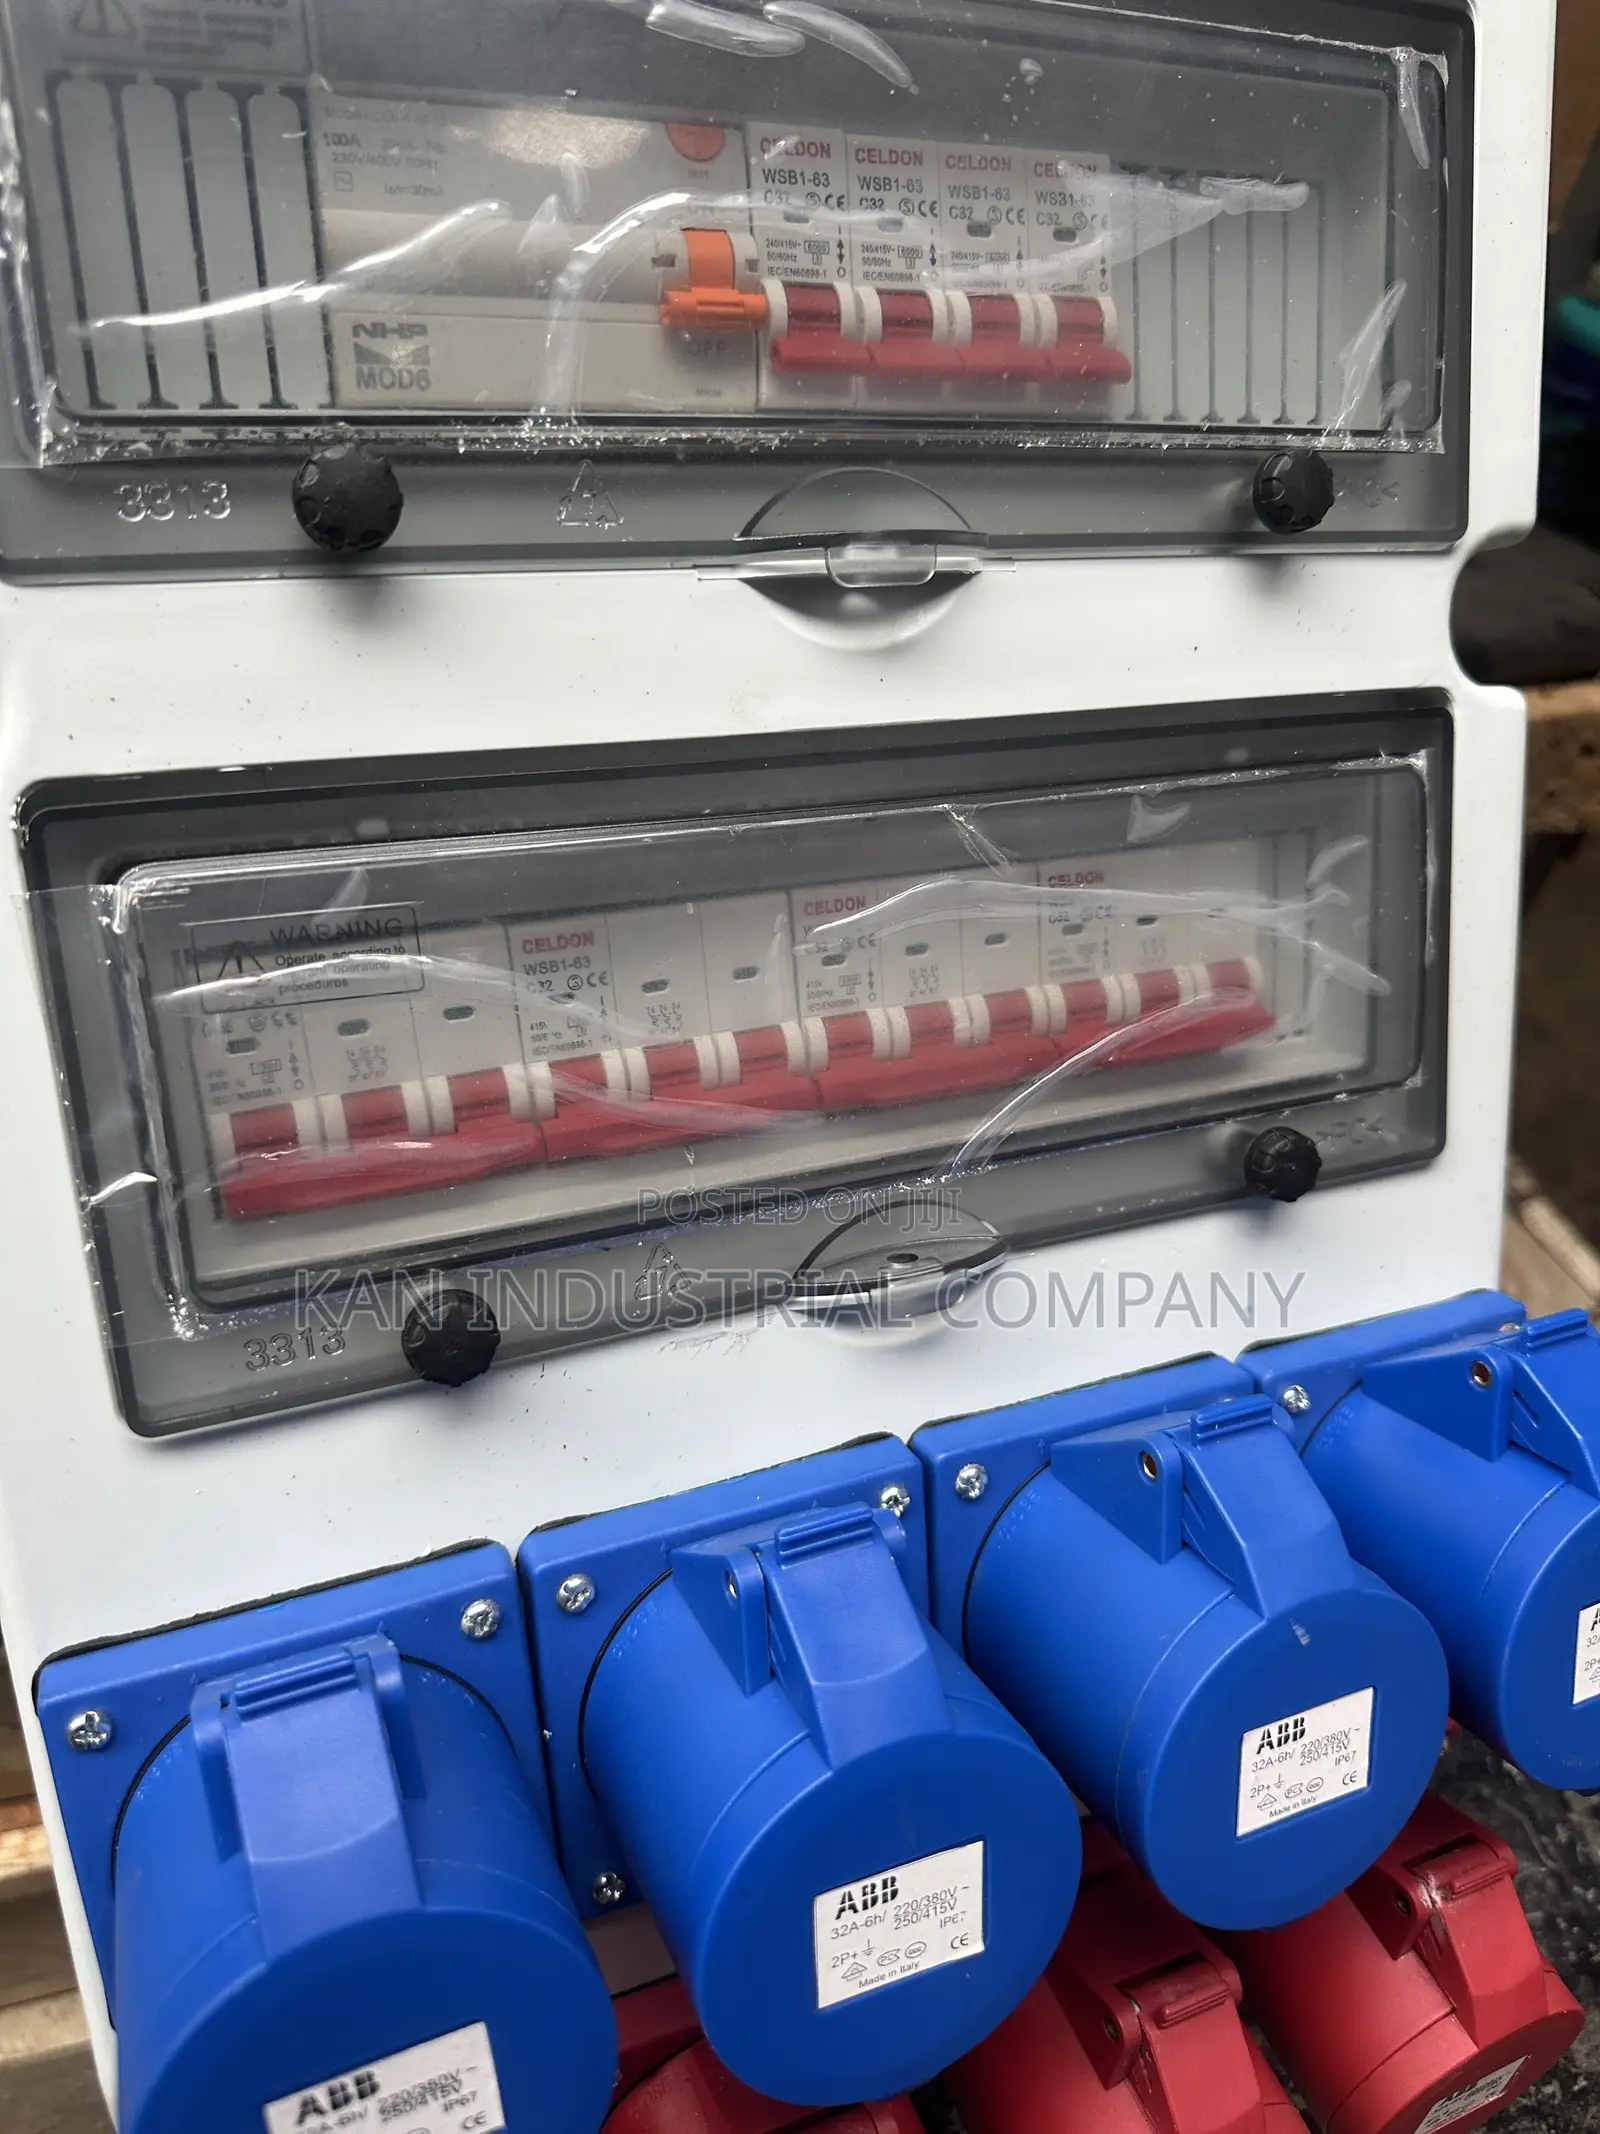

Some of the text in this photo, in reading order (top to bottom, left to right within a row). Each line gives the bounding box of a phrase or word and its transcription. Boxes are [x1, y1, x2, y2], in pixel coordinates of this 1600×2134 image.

[855, 148, 923, 166] CELDON
[945, 155, 1012, 172] CELDON
[762, 168, 830, 188] WSB1-63
[857, 175, 923, 194] WSB1-63
[764, 189, 792, 206] C32
[947, 185, 1011, 201] WSB1-63
[918, 200, 938, 217] CE
[949, 206, 973, 220] C32
[1005, 207, 1025, 225] CE
[1036, 213, 1062, 226] C32
[352, 322, 428, 339] NHP
[356, 366, 432, 392] MOD6
[114, 480, 232, 523] 3313
[804, 896, 866, 915] CELDON
[269, 917, 403, 945] WARNING
[522, 931, 594, 954] CELDON
[275, 952, 326, 968] Operate
[394, 944, 406, 955] to
[522, 955, 591, 976] WSB1-63
[587, 971, 608, 987] CE
[244, 1325, 346, 1371] 3313
[1256, 1716, 1306, 1755] ABB
[1301, 1727, 1351, 1753] 220/380V
[1251, 1739, 1350, 1773] 32A-6h/ 250/415V
[1334, 1750, 1357, 1766] IP67
[1342, 1770, 1358, 1786] CE
[1250, 1784, 1271, 1799] 2P+
[1269, 1795, 1317, 1818] Made in Italy
[835, 1875, 899, 1920] ABB
[893, 1885, 957, 1918] 220/380V
[831, 1898, 957, 1940] 32A-6h/ 250/415V
[939, 1910, 966, 1930] IP67
[950, 1932, 969, 1950] CE
[831, 1951, 858, 1969] 2P+
[858, 1961, 920, 1989] Made in Italy
[296, 2069, 381, 2125] ABB
[441, 2090, 478, 2112] IP67
[462, 2110, 487, 2130] CE
